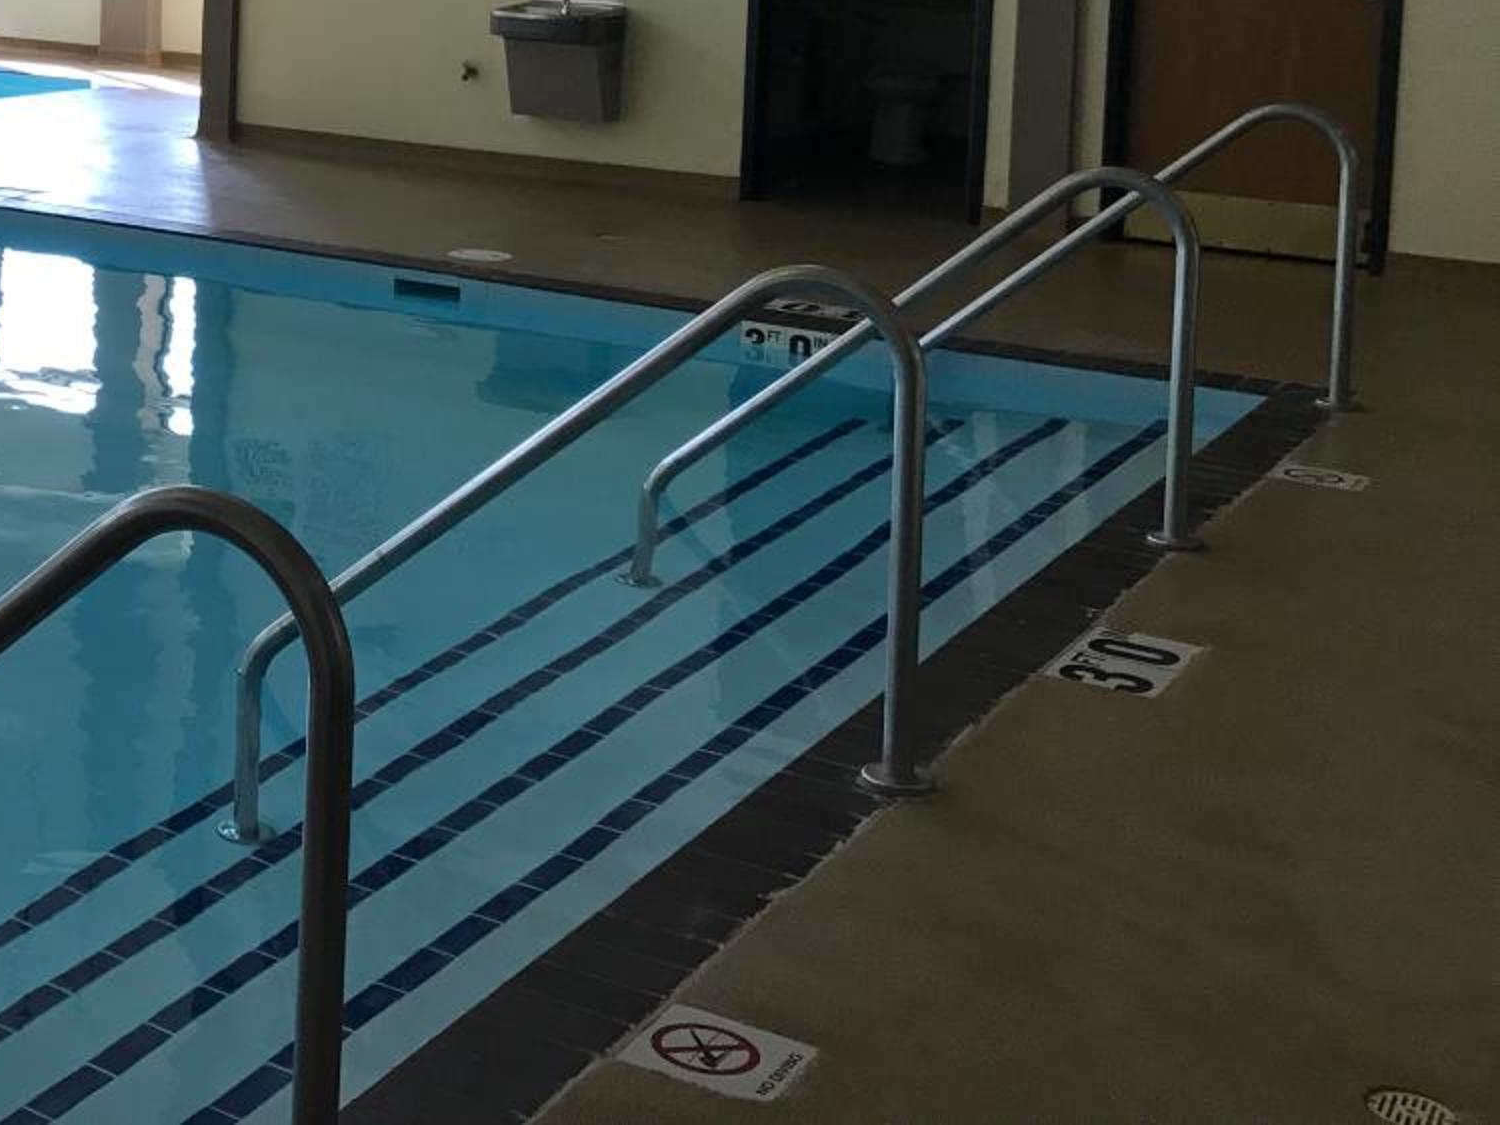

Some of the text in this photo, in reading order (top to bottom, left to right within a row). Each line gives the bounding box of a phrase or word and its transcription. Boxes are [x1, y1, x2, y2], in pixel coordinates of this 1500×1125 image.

[1088, 638, 1181, 665] 0
[1059, 664, 1154, 693] 3
[756, 1051, 804, 1096] NO DIVING
